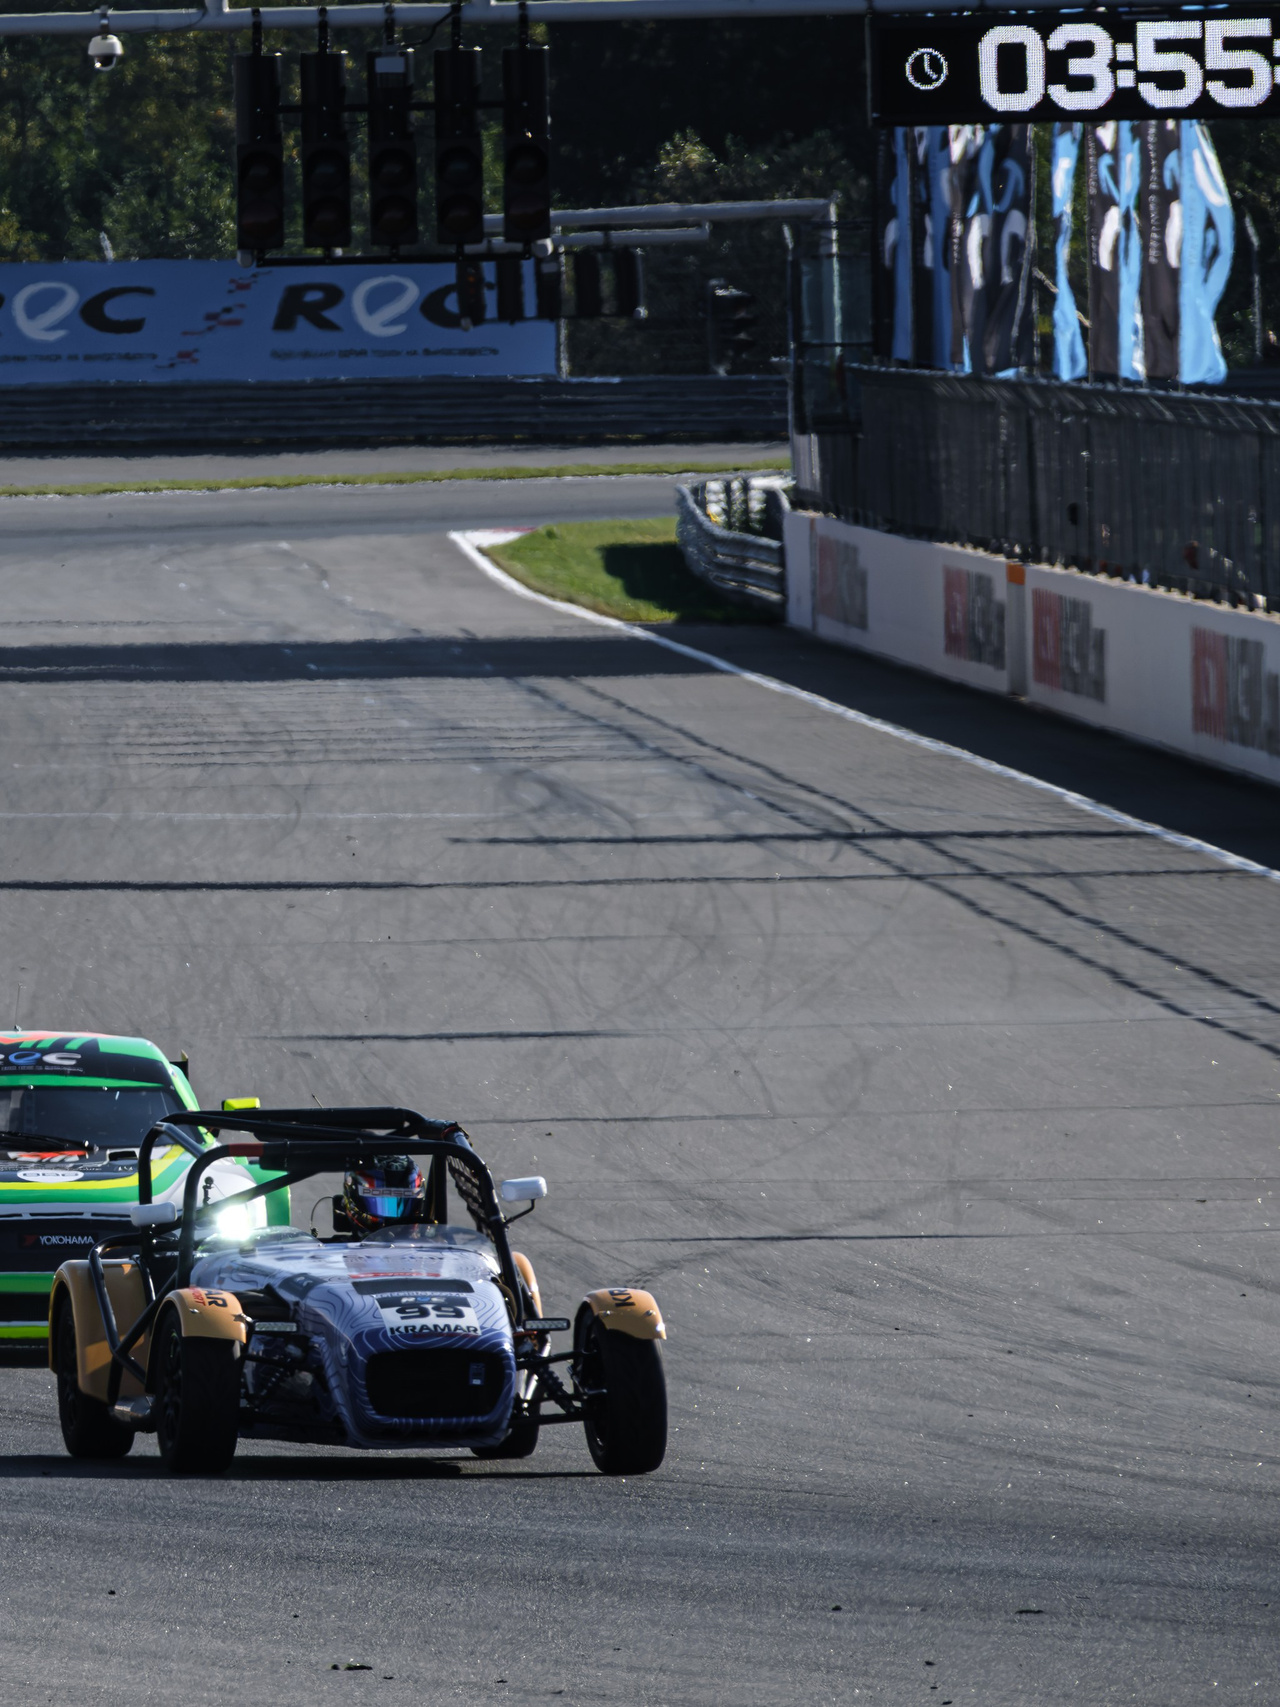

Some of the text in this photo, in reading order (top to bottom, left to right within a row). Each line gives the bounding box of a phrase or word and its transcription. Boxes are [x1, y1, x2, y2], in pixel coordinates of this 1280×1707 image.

[39, 1235, 95, 1246] YOKOHAMA
[396, 1305, 465, 1320] 99
[389, 1324, 480, 1336] KRAMAR
